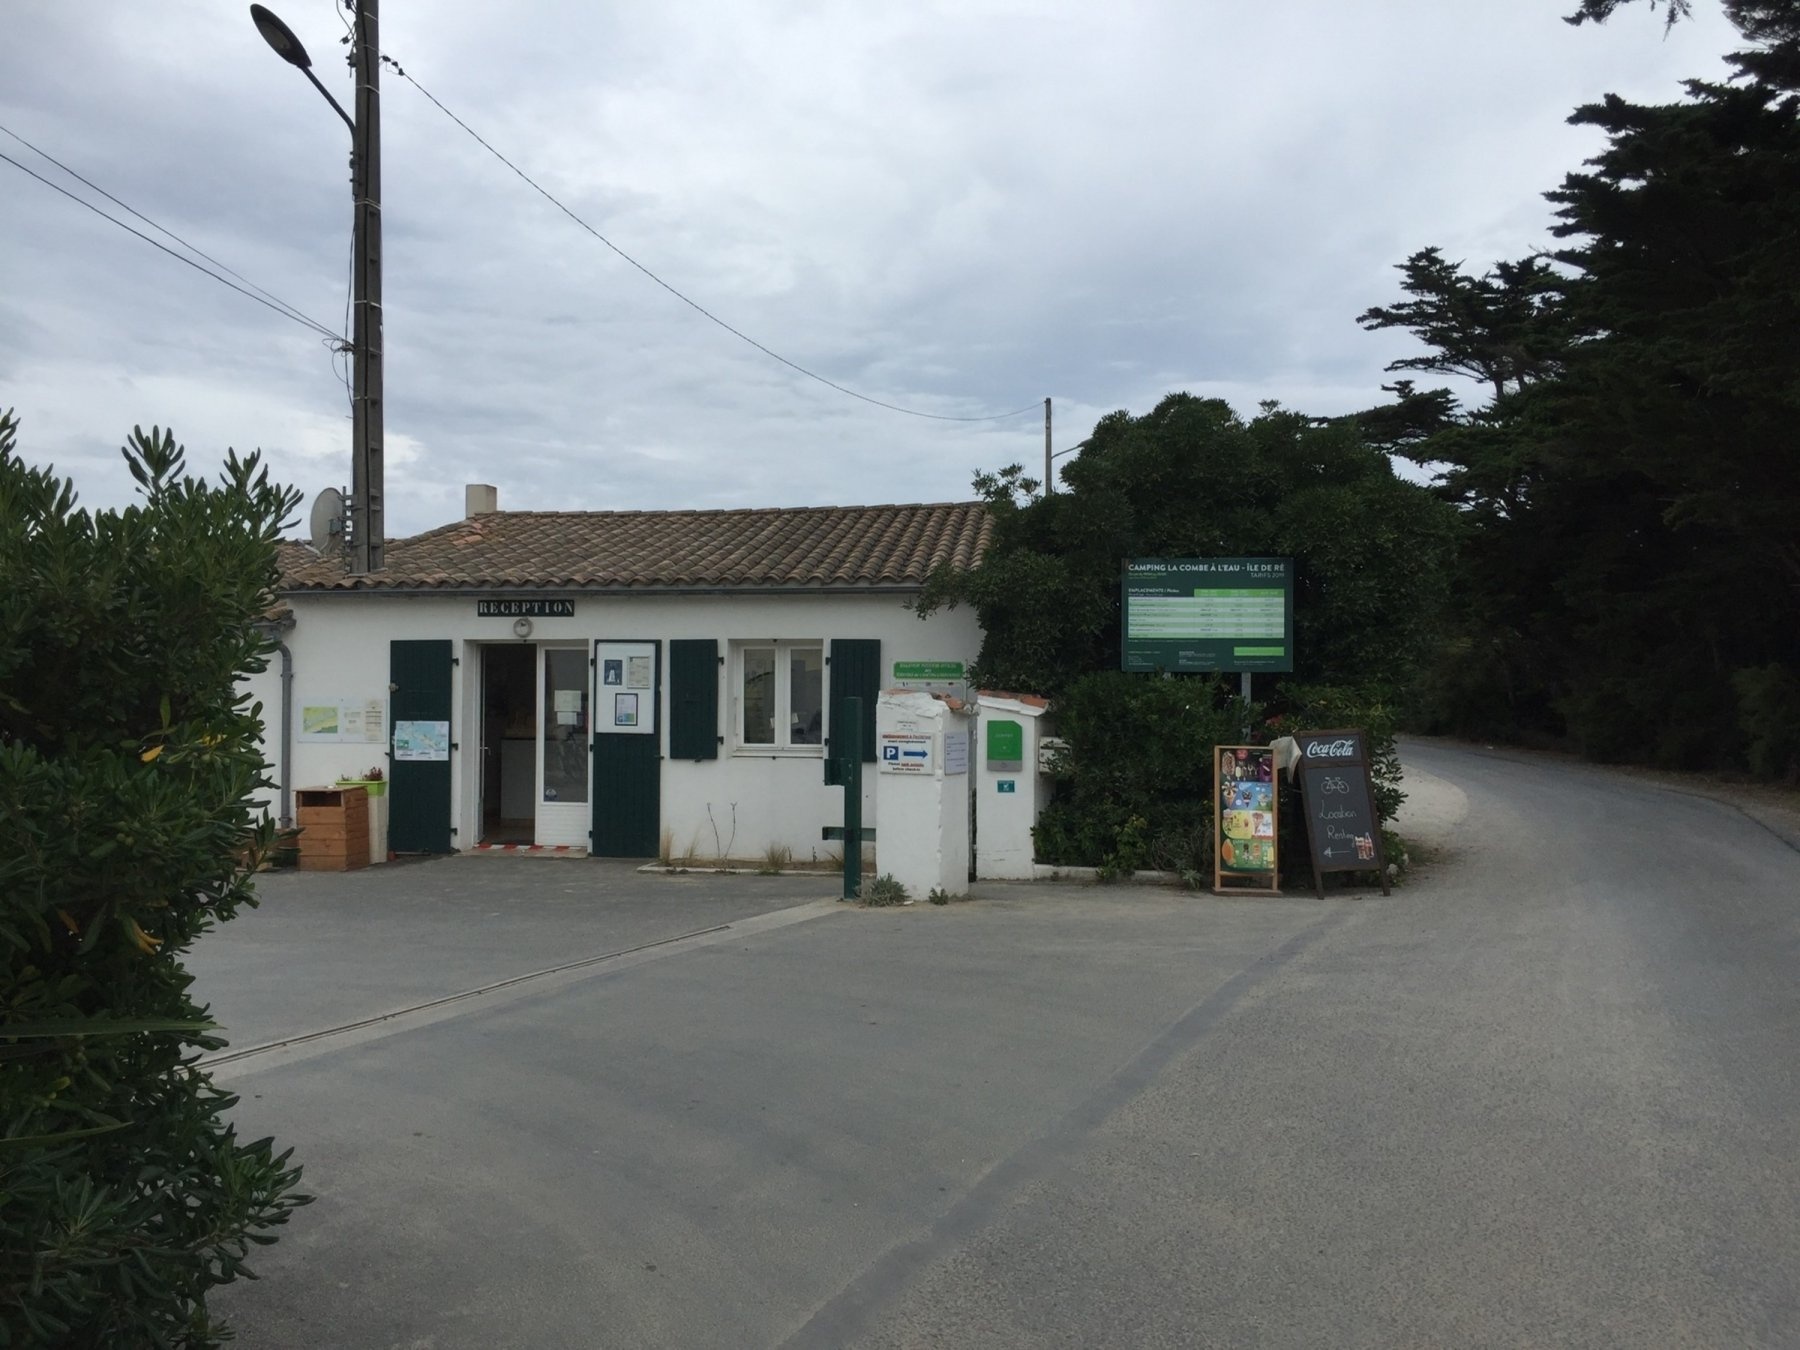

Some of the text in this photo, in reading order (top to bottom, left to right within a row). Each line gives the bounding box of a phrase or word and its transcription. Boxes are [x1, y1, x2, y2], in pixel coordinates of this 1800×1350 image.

[1210, 563, 1216, 571] À
[1246, 562, 1259, 571] ÎLE
[1274, 562, 1285, 571] RÉ
[479, 602, 573, 613] RECEPTION
[886, 747, 896, 759] P
[1307, 740, 1355, 758] Coca-Cola
